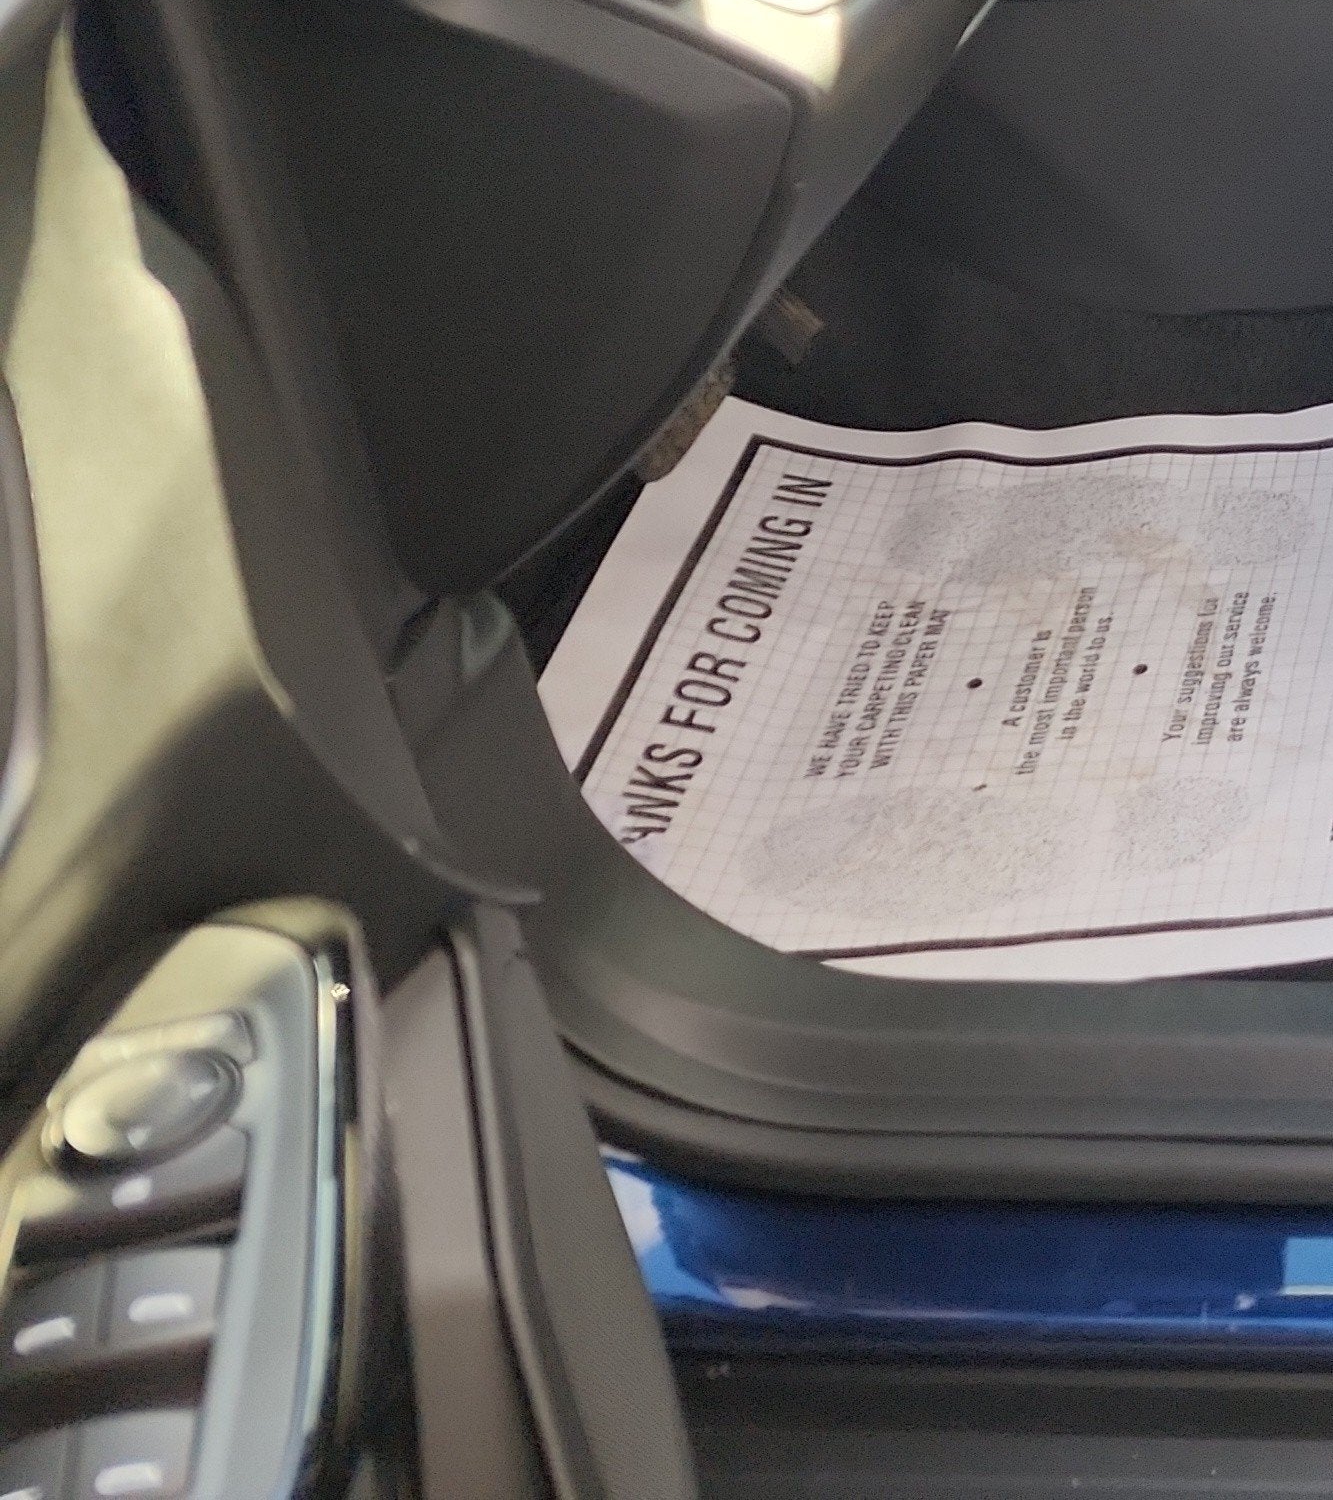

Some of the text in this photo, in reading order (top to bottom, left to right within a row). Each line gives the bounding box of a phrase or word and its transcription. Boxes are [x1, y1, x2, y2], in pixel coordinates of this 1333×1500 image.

[659, 651, 747, 734] FOR
[706, 515, 813, 644] COMING
[771, 473, 834, 508] IN
[1086, 636, 1106, 651] to
[803, 600, 895, 779] WE HAVE TRIED TO KEEP
[834, 601, 926, 778] YOUR CARPETING CLEAN
[869, 609, 950, 770] WITH THIS PAPER MAT
[1009, 647, 1045, 713] customer
[1014, 587, 1099, 775] the most important person
[1062, 698, 1086, 721] the
[1075, 653, 1100, 694] world
[1161, 709, 1188, 742] Your
[1177, 621, 1214, 704] suggestions
[1192, 592, 1249, 745] improving our service
[1231, 660, 1262, 712] always
[1001, 715, 1023, 727] A
[1227, 717, 1247, 742] are
